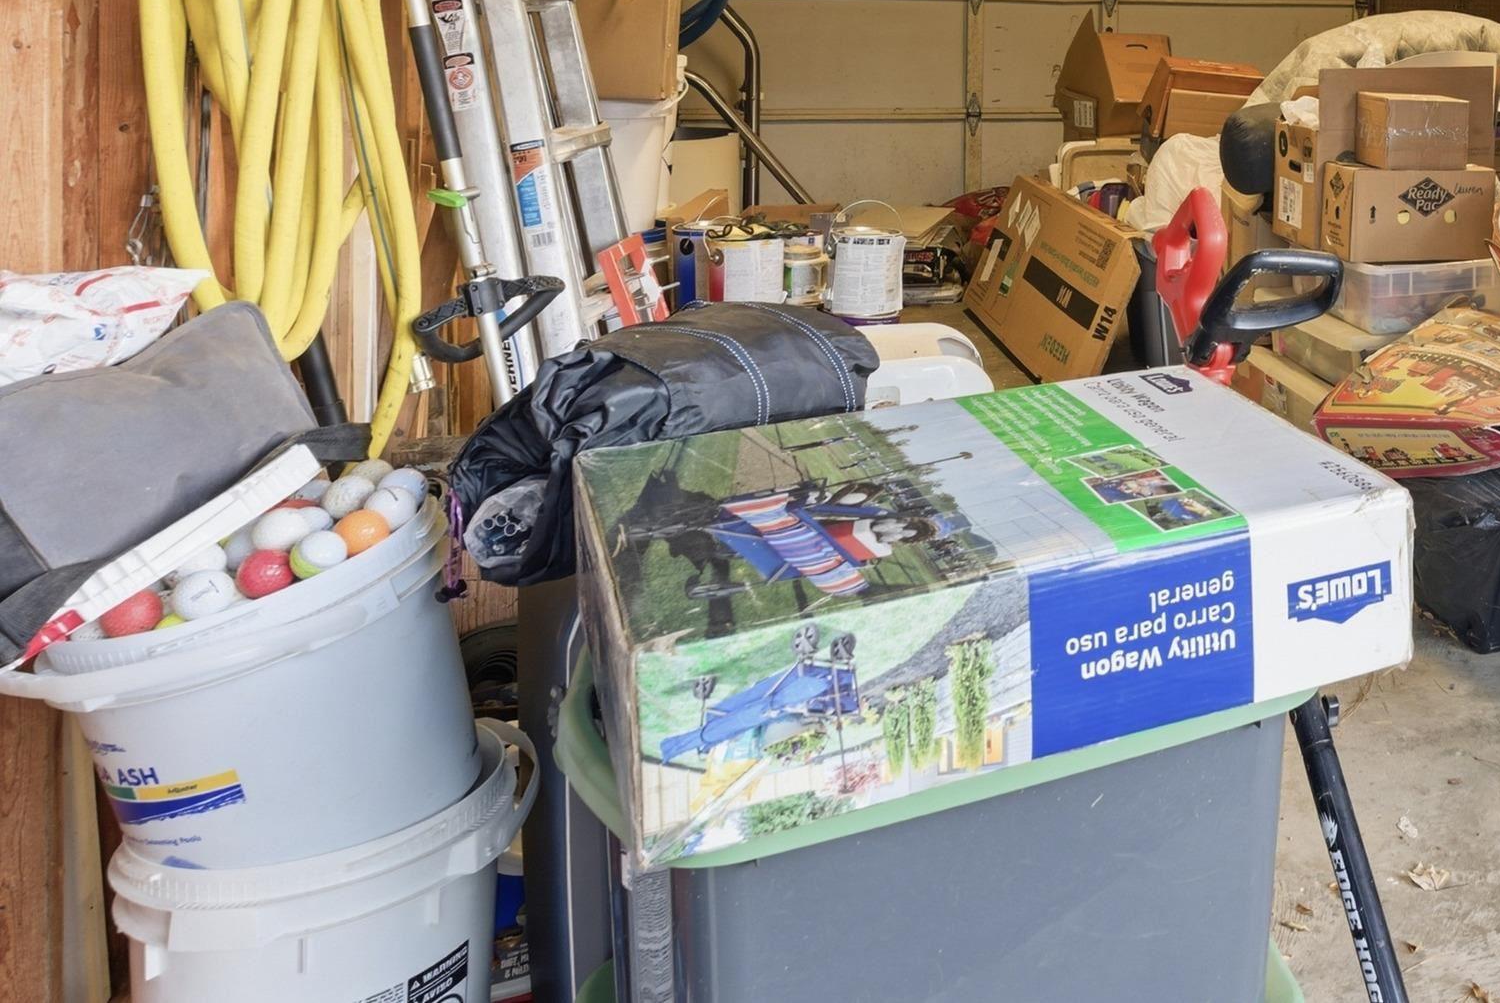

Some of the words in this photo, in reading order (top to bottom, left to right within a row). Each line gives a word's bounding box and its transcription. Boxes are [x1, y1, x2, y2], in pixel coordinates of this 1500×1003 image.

[1407, 187, 1448, 203] Ready
[1416, 199, 1440, 211] Pac
[1092, 305, 1118, 342] W14
[1148, 570, 1235, 614] general
[1296, 567, 1383, 610] LOWE'S
[1114, 610, 1168, 644] para
[1174, 601, 1236, 630] Carro
[1065, 631, 1108, 656] uso
[1167, 628, 1237, 661] Utility
[1080, 648, 1163, 681] Wagon
[117, 766, 160, 787] ASH
[1329, 849, 1364, 933] EDGE
[1354, 936, 1385, 1003] HOG
[421, 946, 468, 984] WARNING
